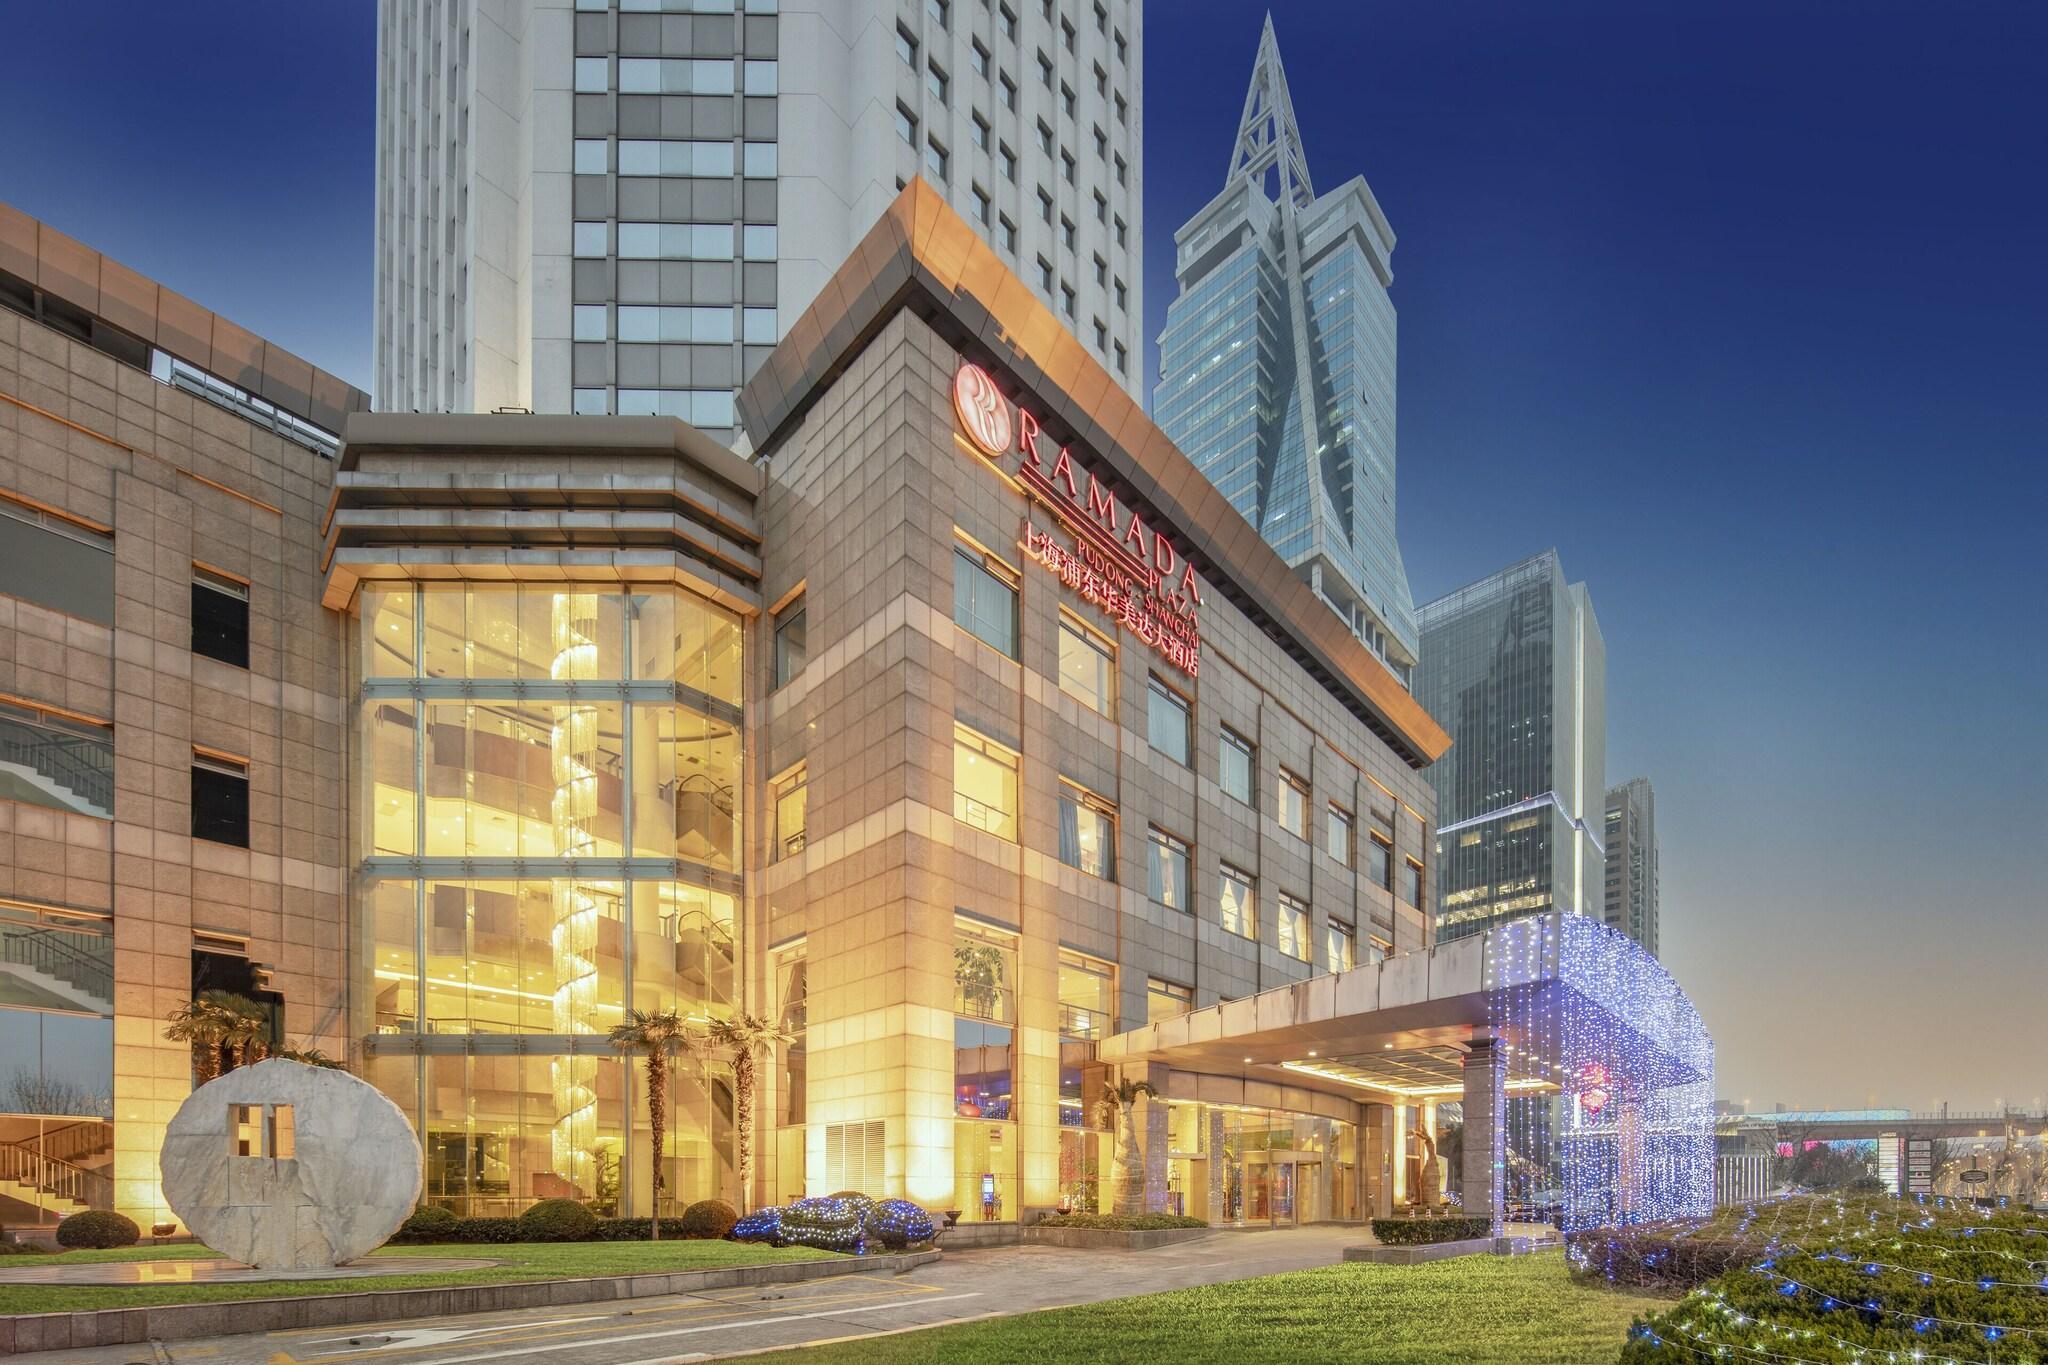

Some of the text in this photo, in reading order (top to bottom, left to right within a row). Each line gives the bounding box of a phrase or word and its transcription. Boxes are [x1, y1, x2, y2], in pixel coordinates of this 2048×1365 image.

[1019, 408, 1199, 603] RAMADA
[1024, 520, 1198, 677] 上海浦东华美达大酒店
[1078, 537, 1199, 648] PUDONG SHANGHAI
[1148, 569, 1199, 627] PLAZA
